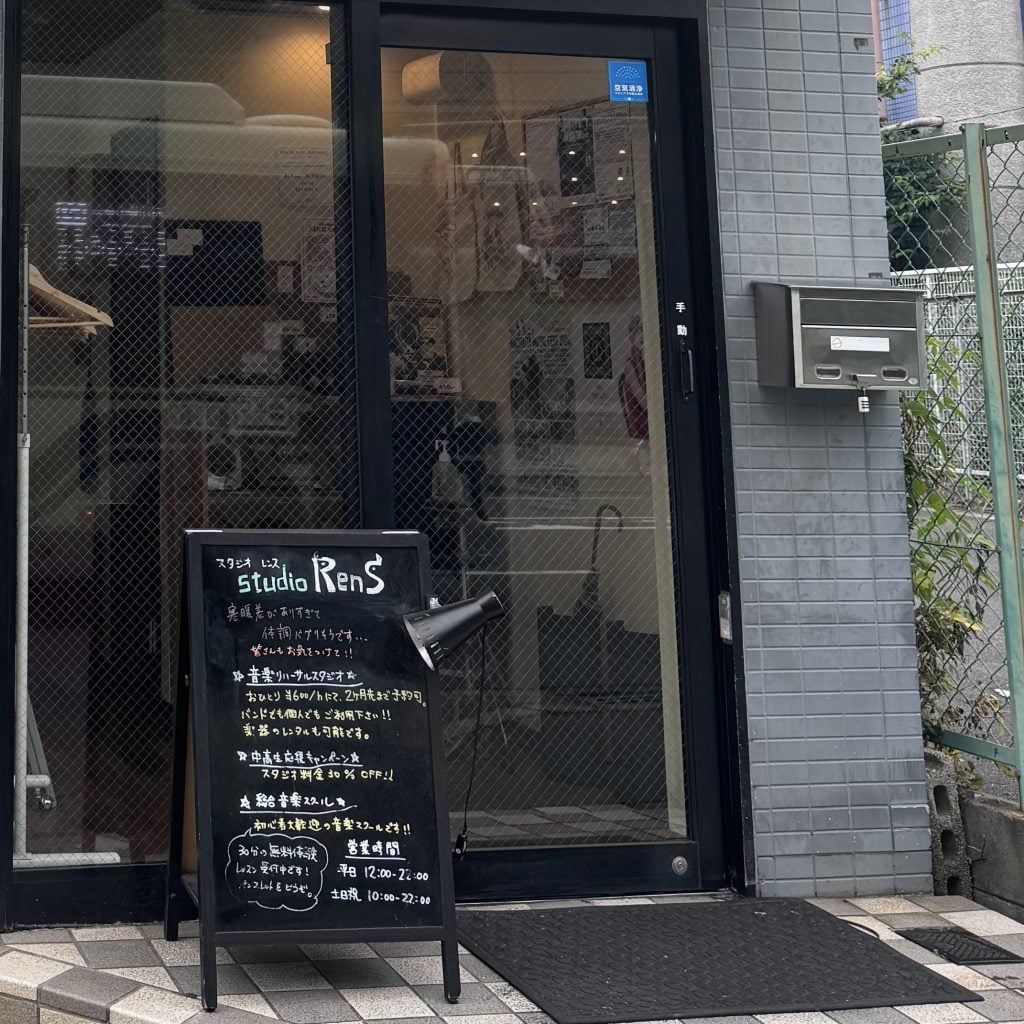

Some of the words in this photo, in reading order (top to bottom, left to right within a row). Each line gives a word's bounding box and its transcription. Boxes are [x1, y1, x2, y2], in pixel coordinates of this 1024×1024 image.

[676, 302, 688, 336] 手動
[216, 557, 252, 569] スタジオ
[261, 558, 280, 569] レンス
[238, 564, 309, 594] studio
[347, 839, 401, 856] 営業時間
[337, 863, 357, 878] 平日
